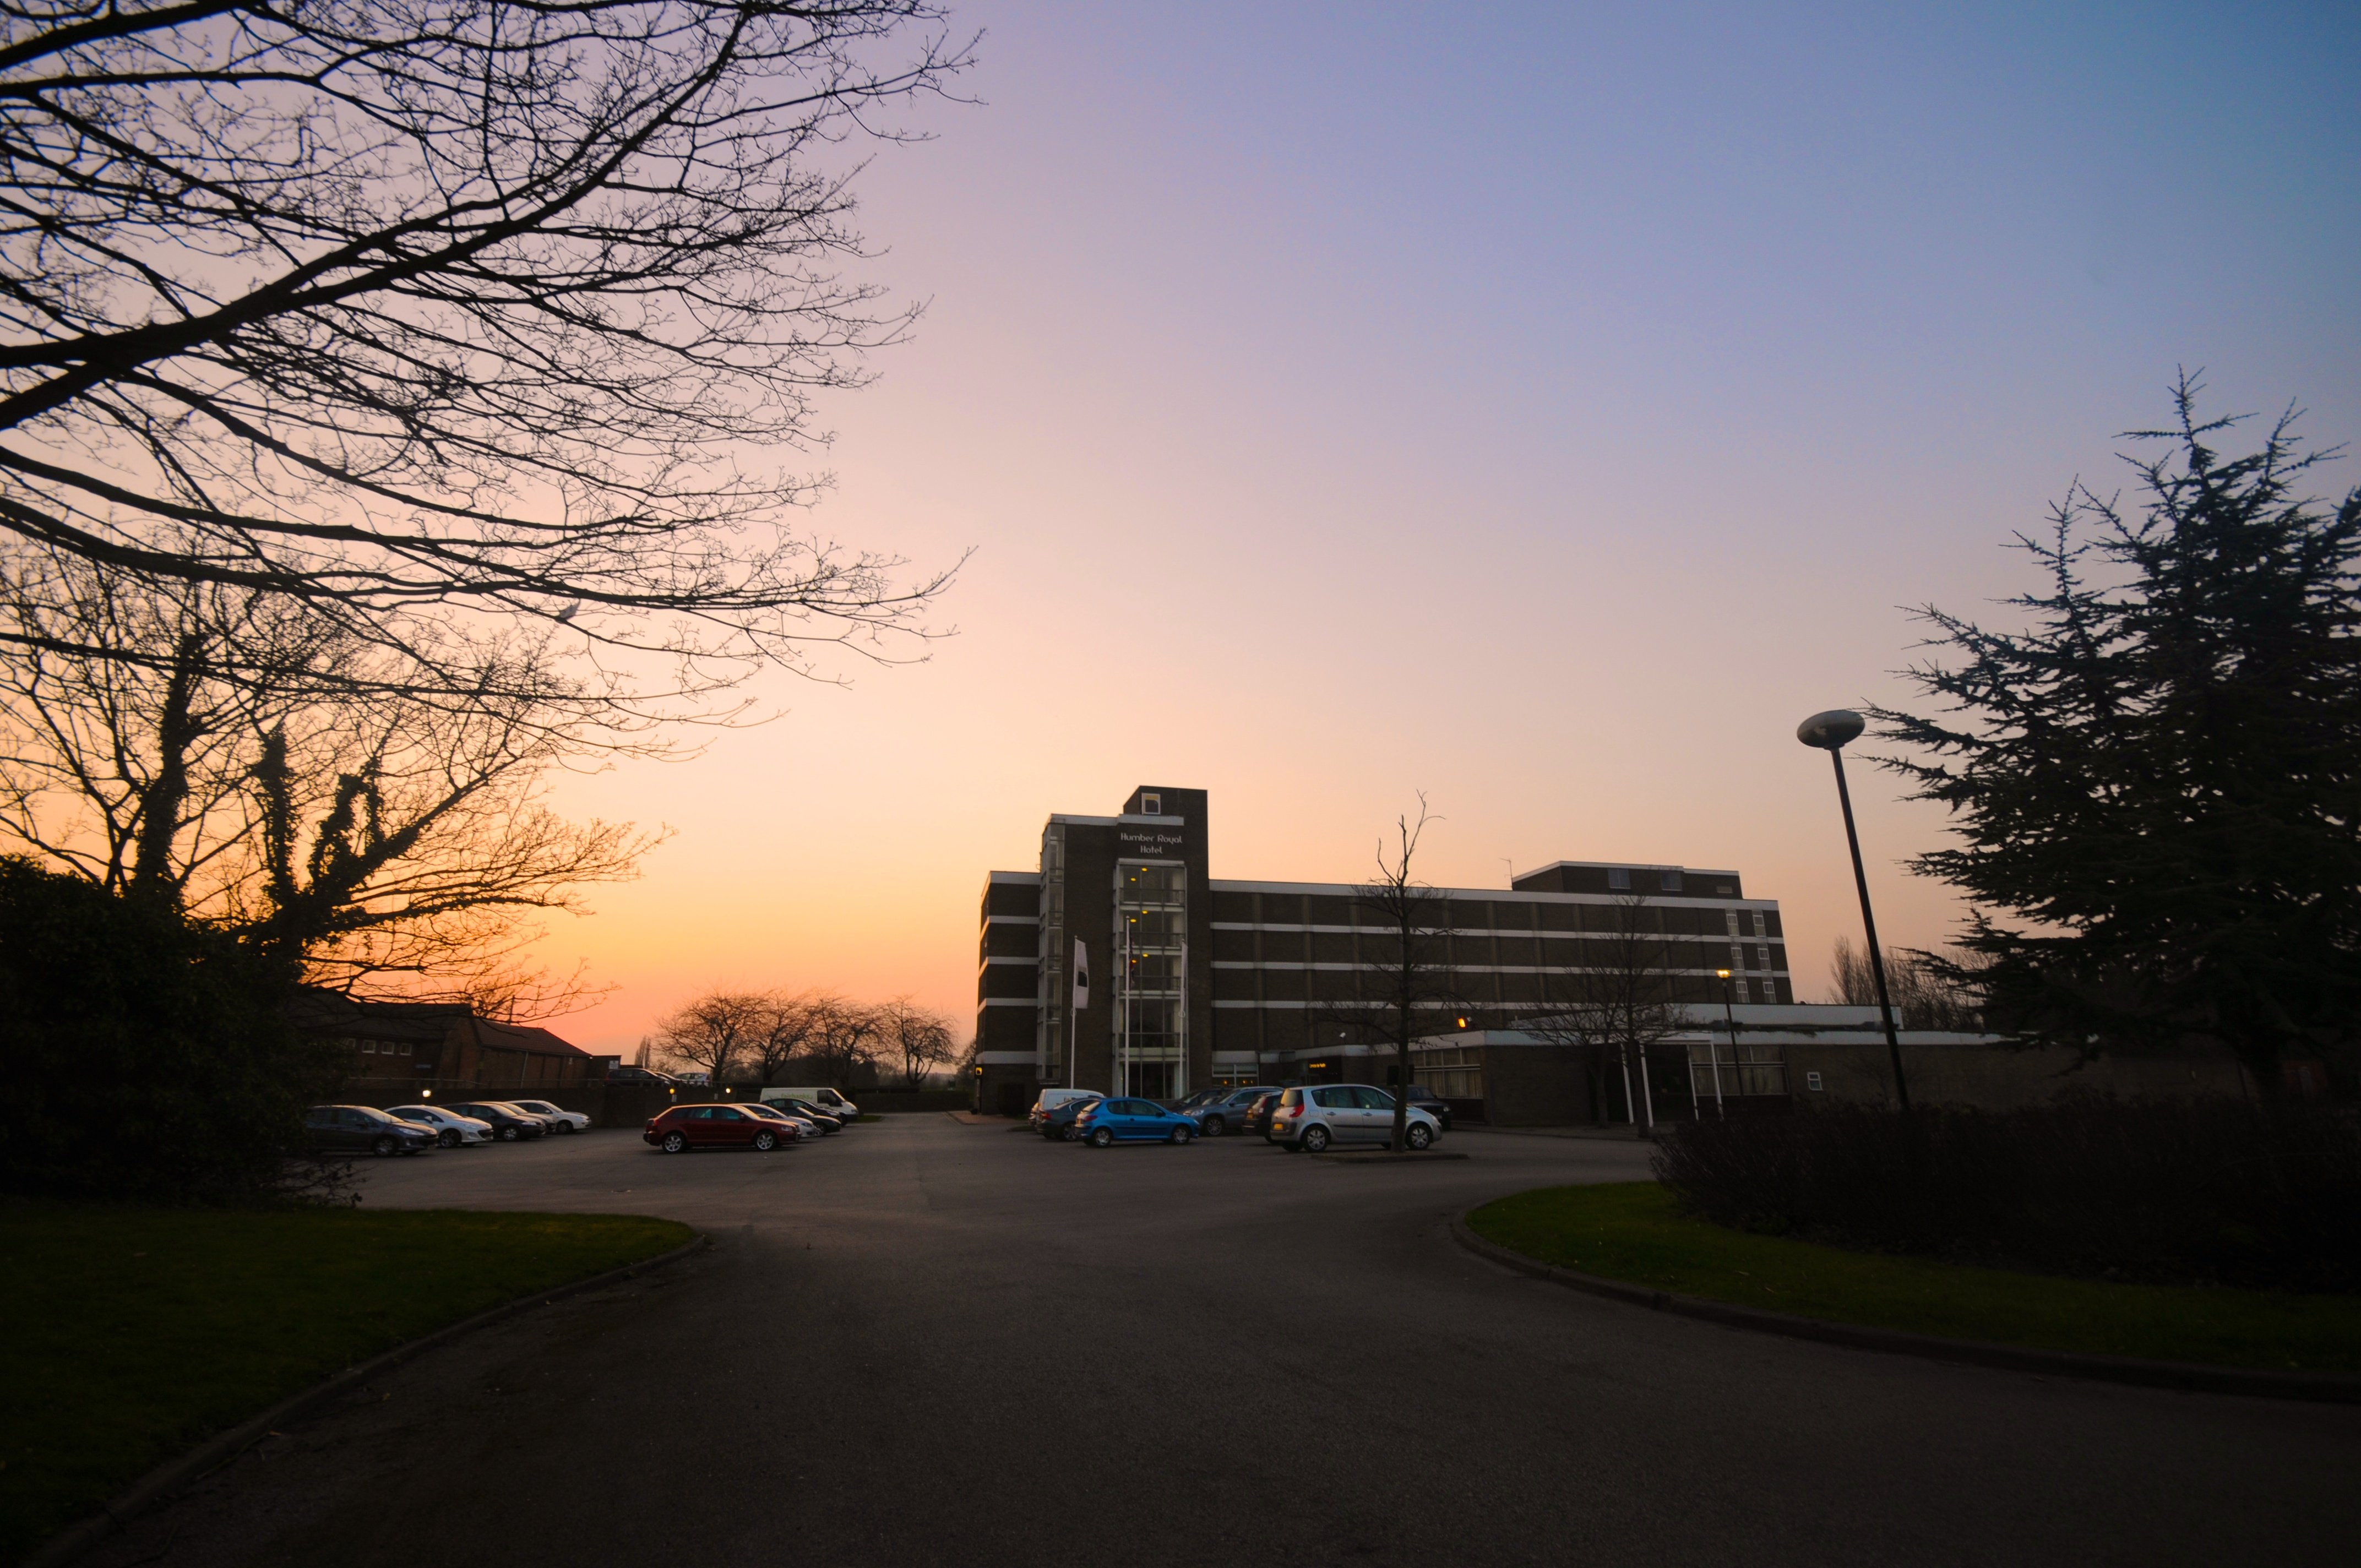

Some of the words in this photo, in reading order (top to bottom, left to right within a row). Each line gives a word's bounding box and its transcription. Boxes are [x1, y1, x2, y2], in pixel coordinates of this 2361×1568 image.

[1120, 832, 1155, 842] Humber
[1157, 834, 1182, 845] Royal
[1140, 845, 1163, 854] Hotel
